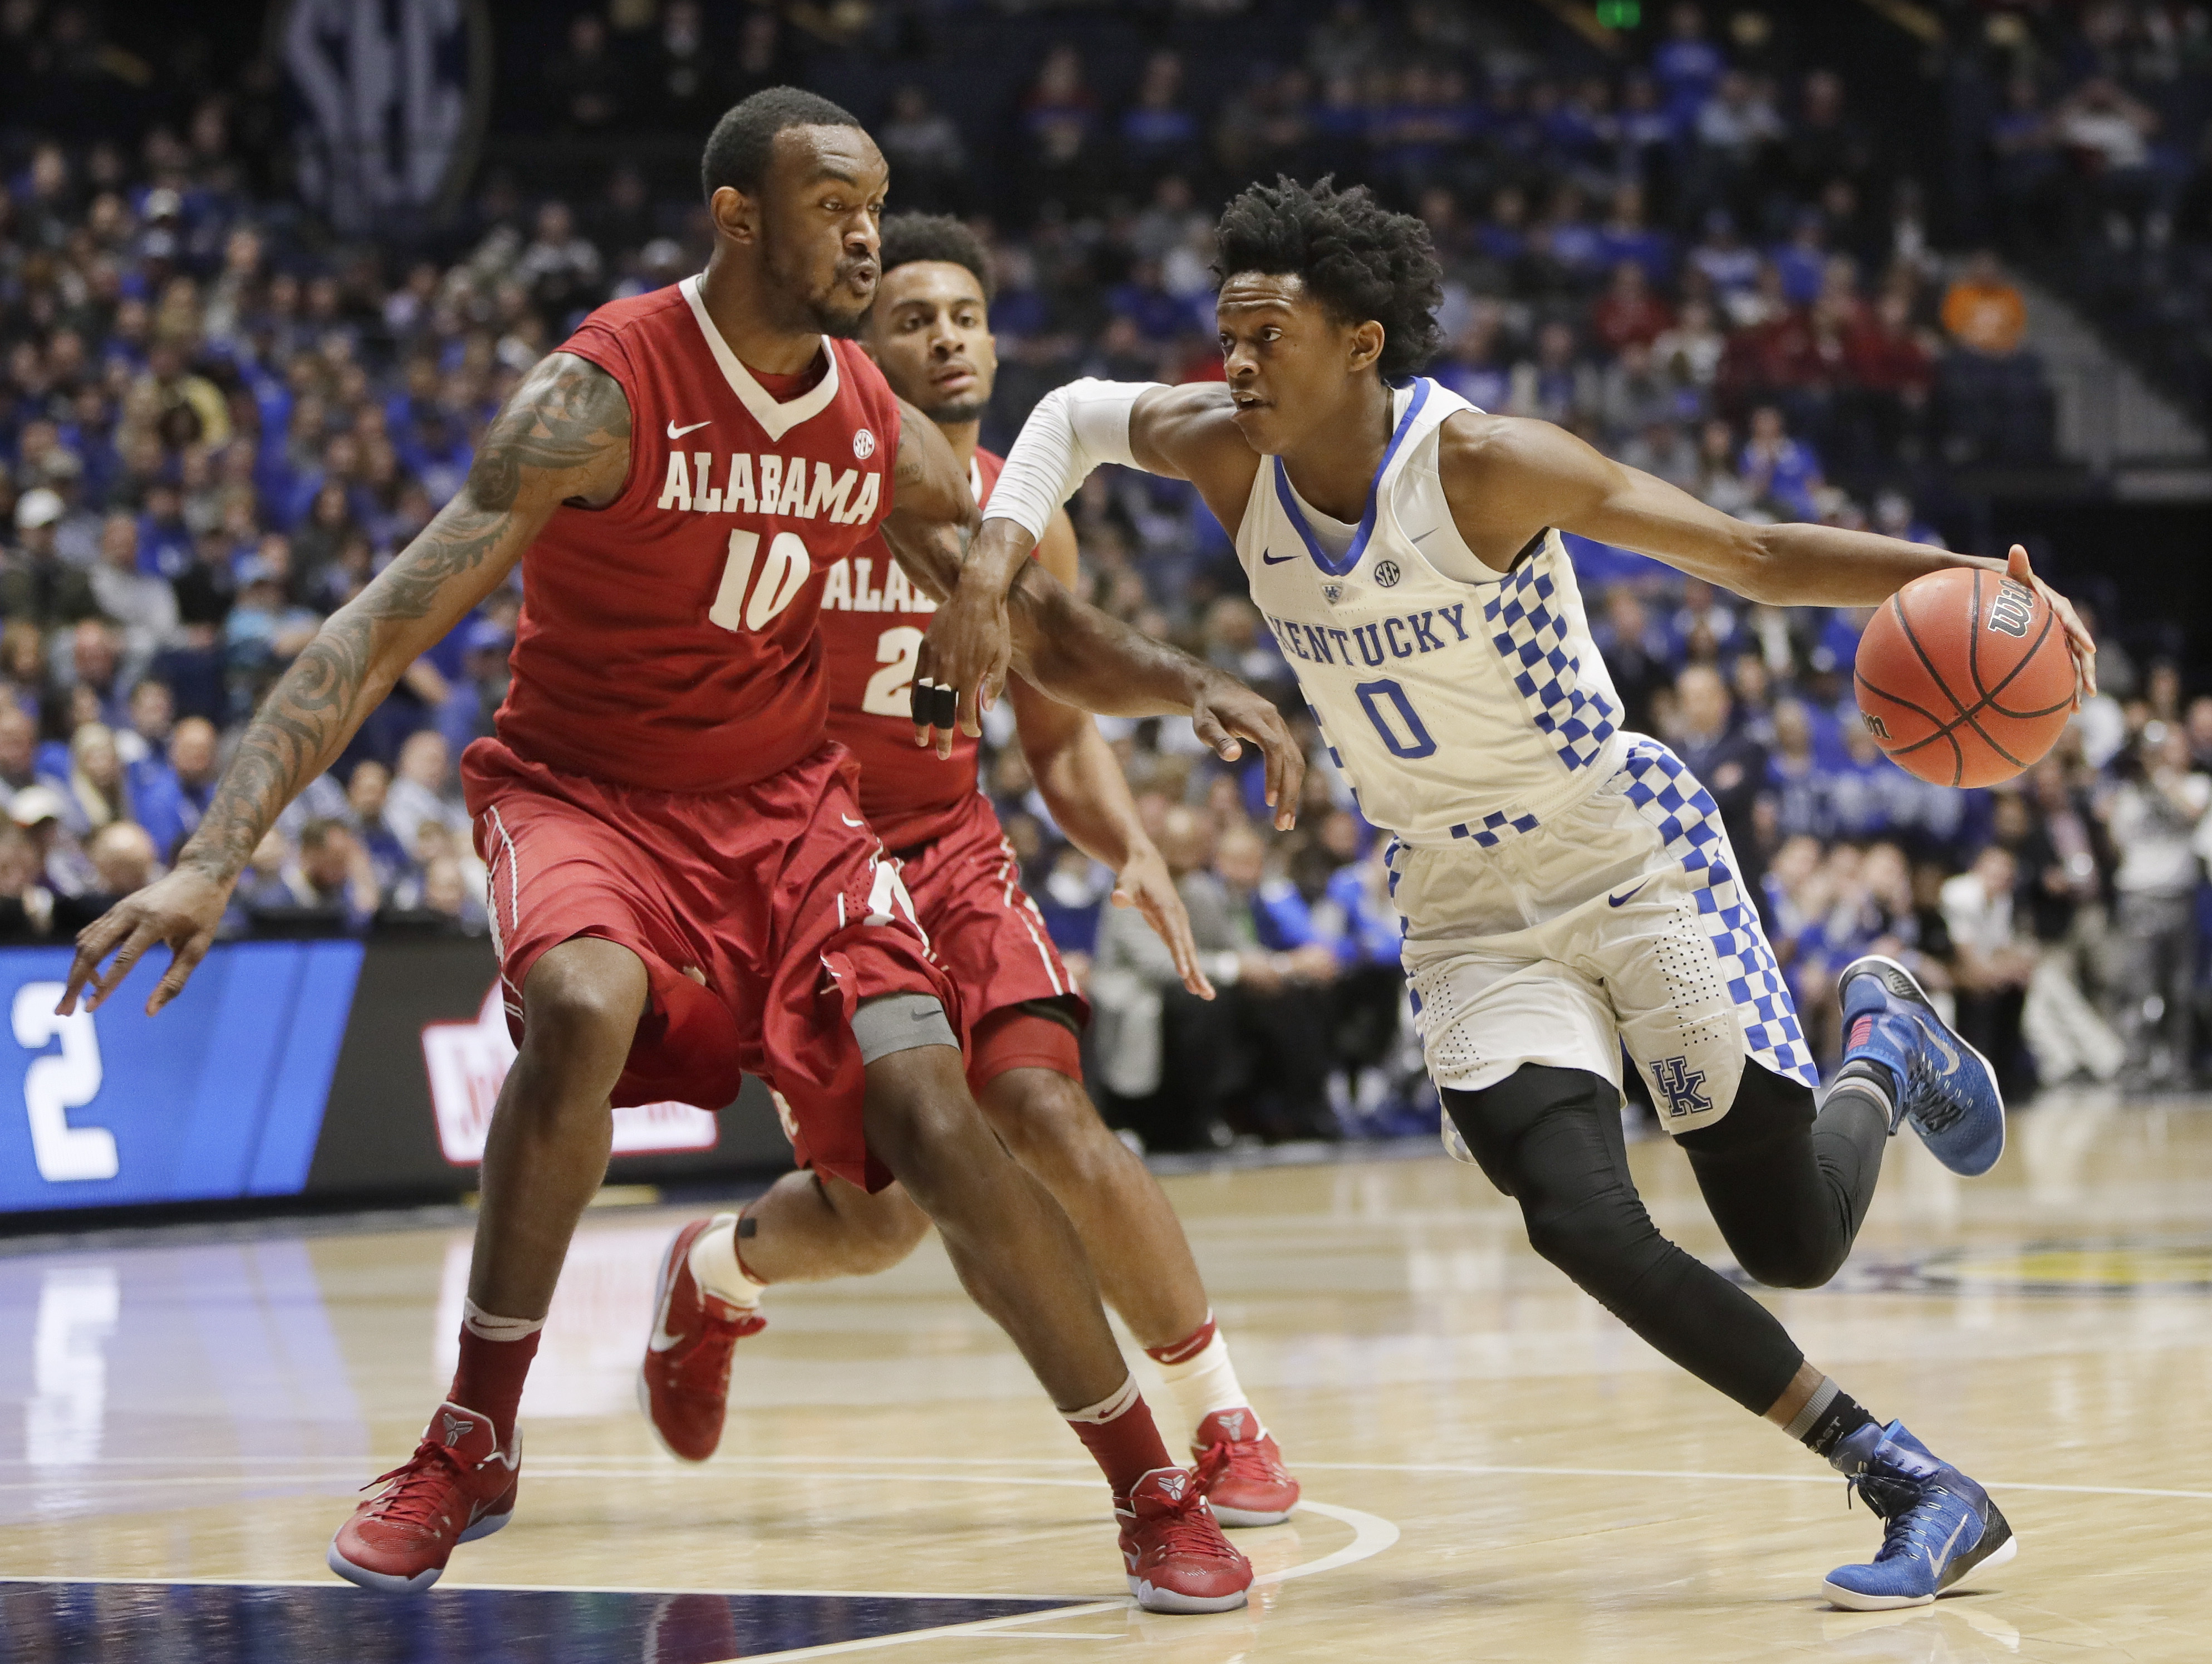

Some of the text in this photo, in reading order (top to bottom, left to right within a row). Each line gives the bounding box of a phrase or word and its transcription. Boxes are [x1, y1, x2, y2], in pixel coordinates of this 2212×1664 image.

[854, 430, 874, 458] SEC
[657, 451, 881, 526] ALABAMA
[708, 528, 811, 632] 10
[1375, 561, 1400, 588] SEC
[1353, 677, 1438, 760] 0
[11, 981, 119, 1182] 2
